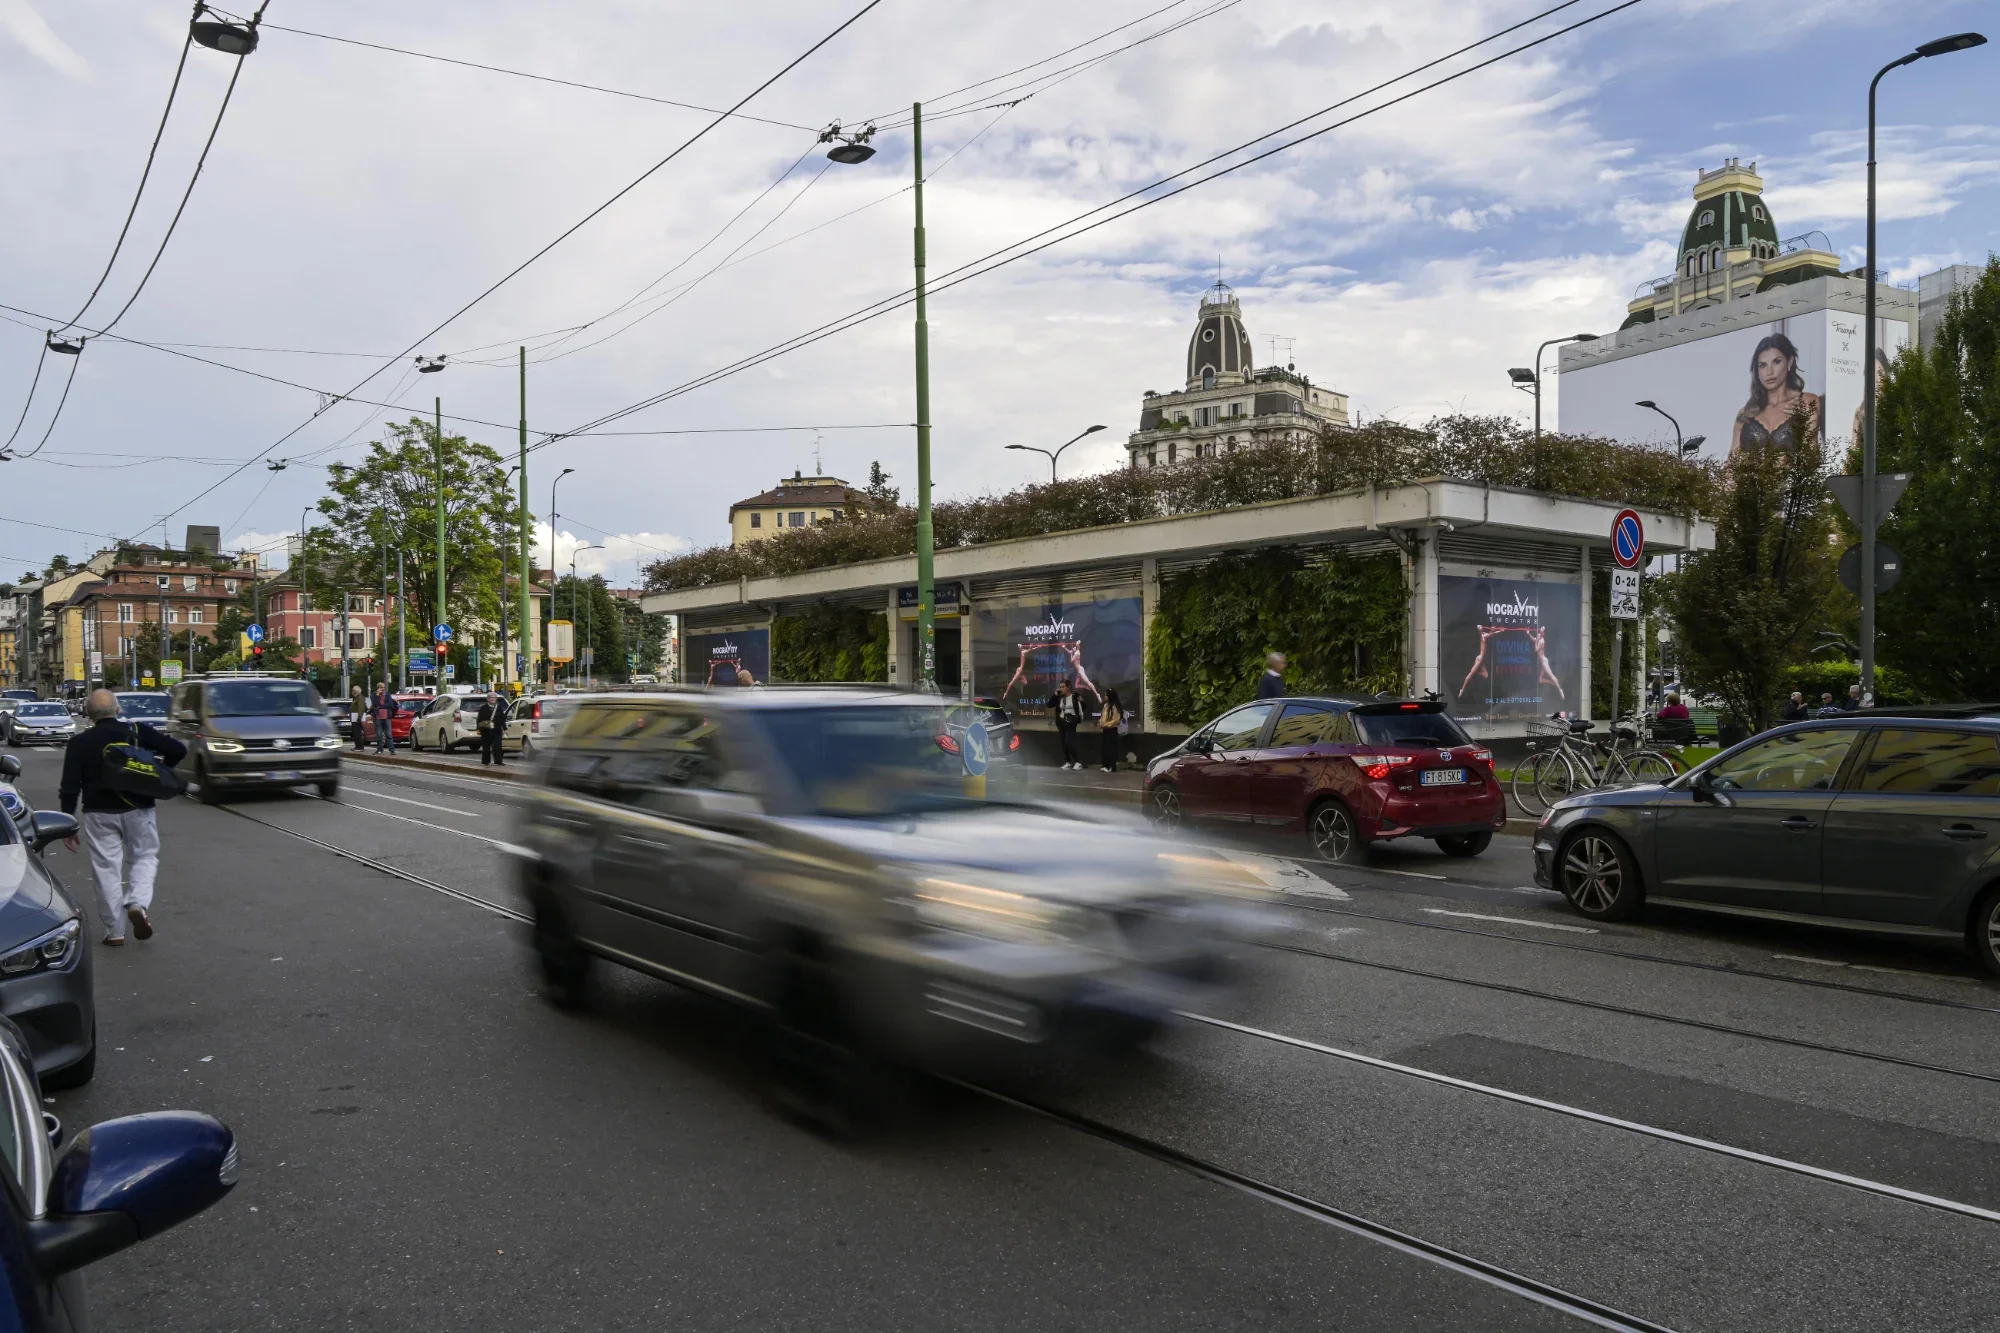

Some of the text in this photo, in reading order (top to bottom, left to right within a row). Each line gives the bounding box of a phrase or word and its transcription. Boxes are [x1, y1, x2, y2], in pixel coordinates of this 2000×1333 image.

[1486, 589, 1540, 617] NOGRAVITY
[1025, 612, 1075, 636] NOGRAVITY
[1488, 616, 1538, 625] THEATRE
